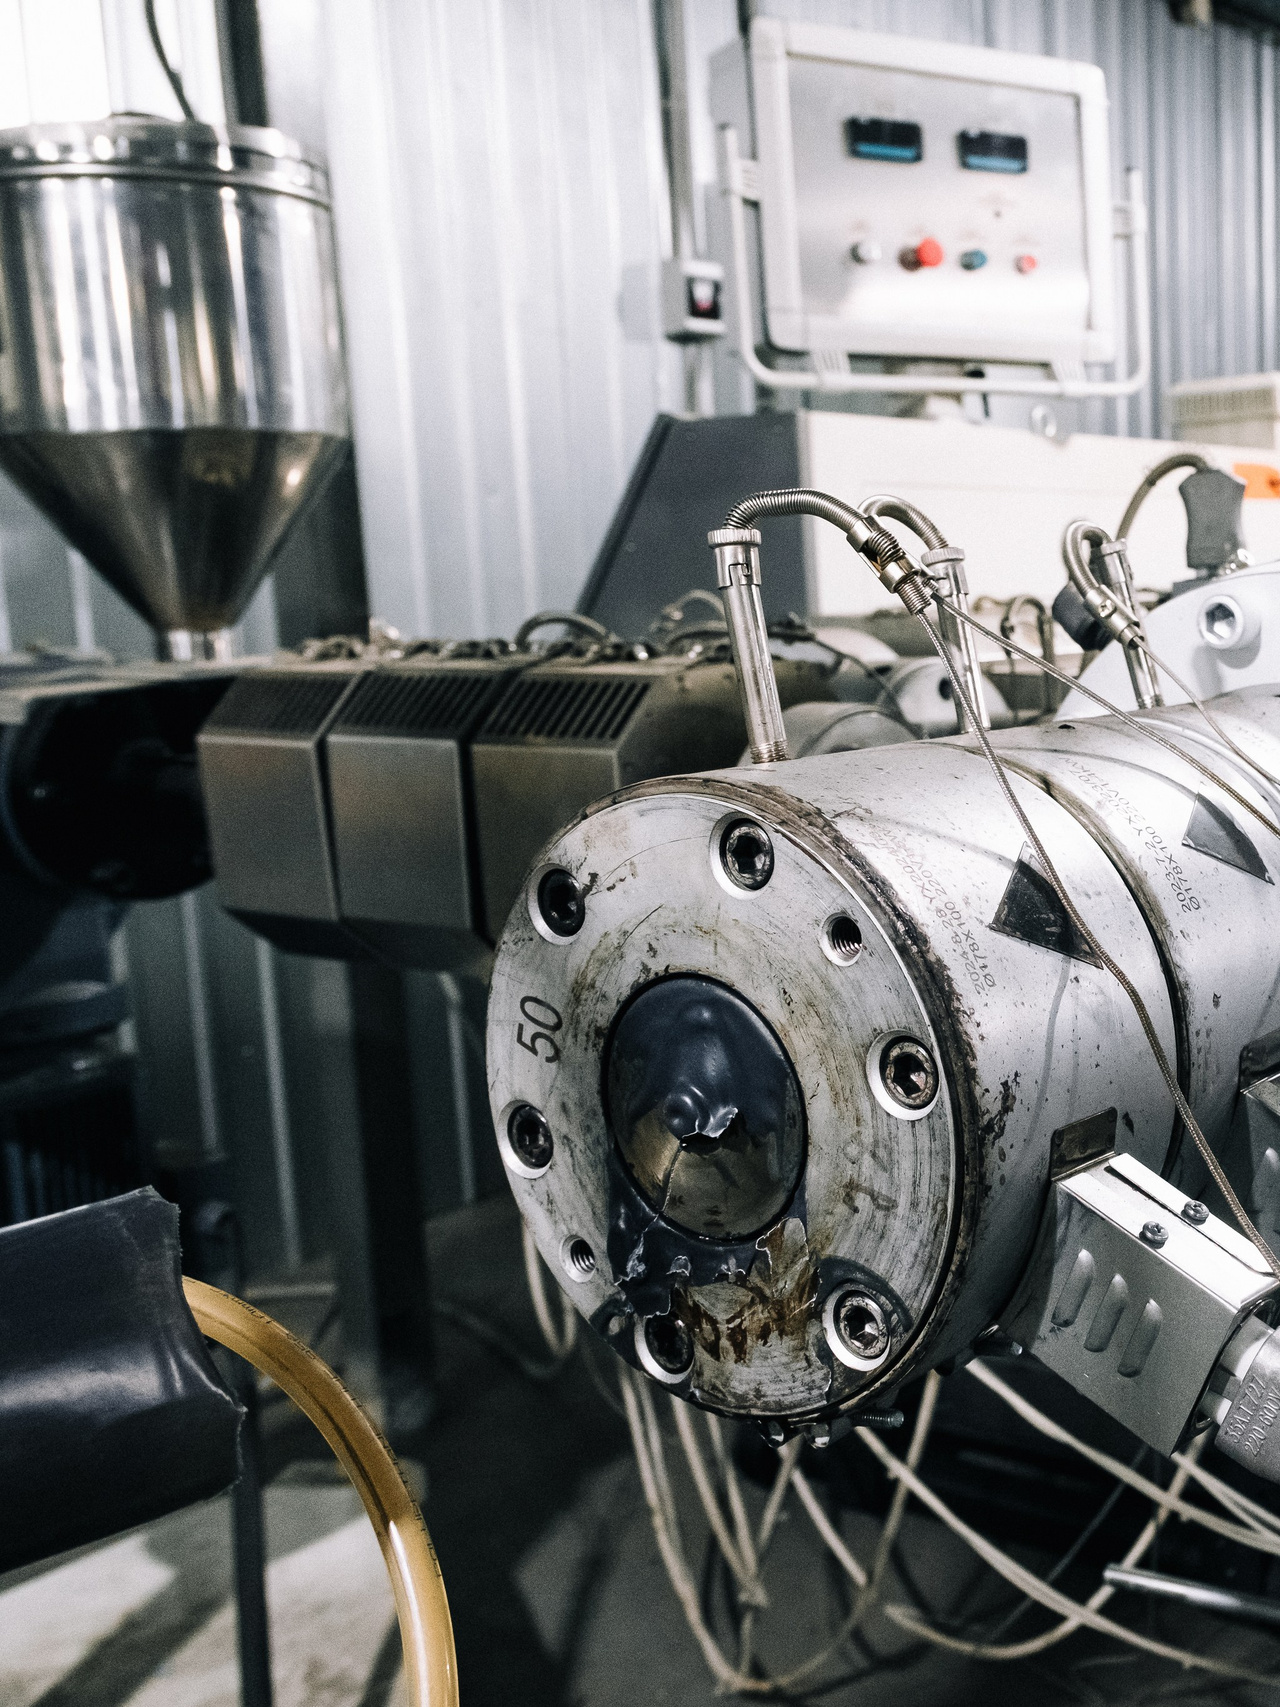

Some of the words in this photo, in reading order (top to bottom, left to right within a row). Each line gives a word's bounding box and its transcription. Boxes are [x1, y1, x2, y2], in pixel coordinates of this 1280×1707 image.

[1145, 840, 1193, 914] 2023-7-2
[935, 905, 986, 995] 2024-8-28
[516, 995, 563, 1063] 50
